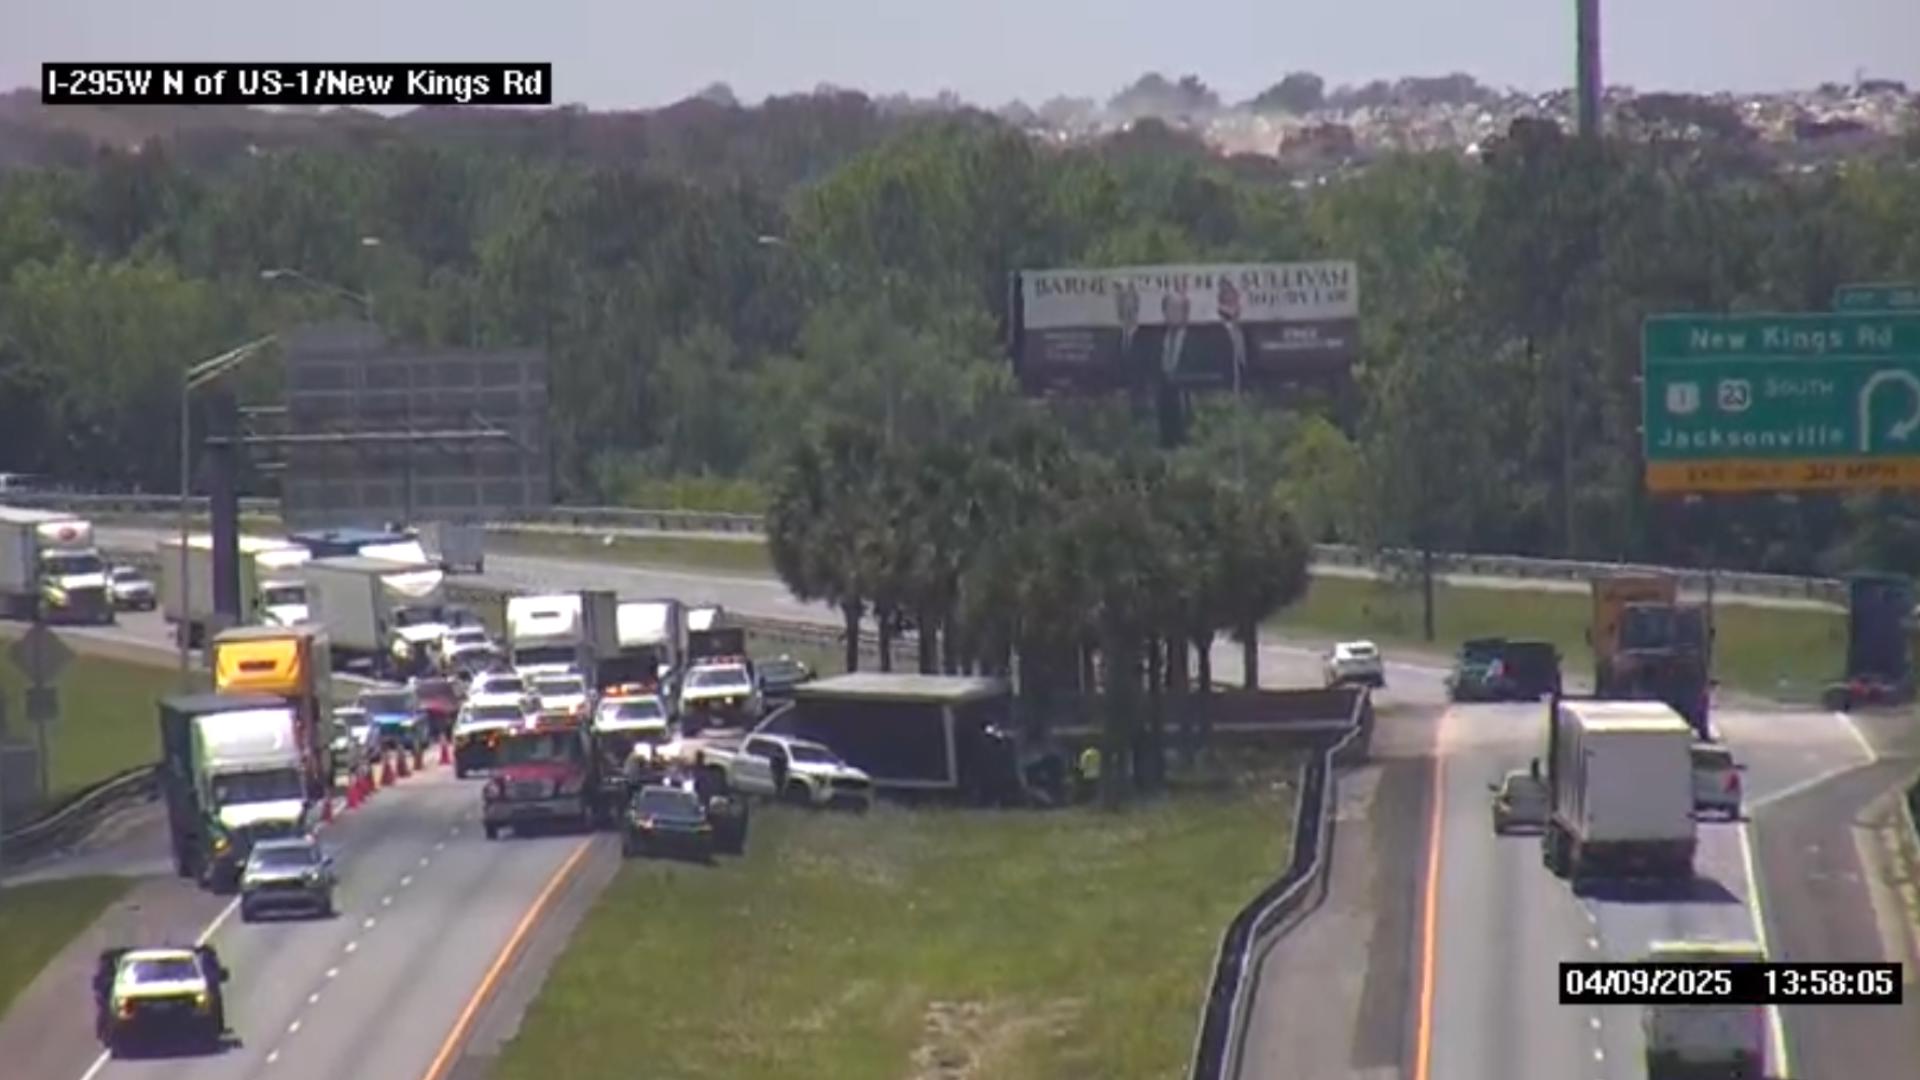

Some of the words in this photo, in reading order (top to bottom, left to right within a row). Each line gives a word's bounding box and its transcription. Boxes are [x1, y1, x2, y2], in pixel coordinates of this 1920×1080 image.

[1690, 328, 1747, 349] New
[1762, 326, 1843, 351] Kings
[1857, 325, 1893, 347] Rd
[1722, 383, 1746, 405] 23
[1657, 423, 1845, 447] Jacksonville
